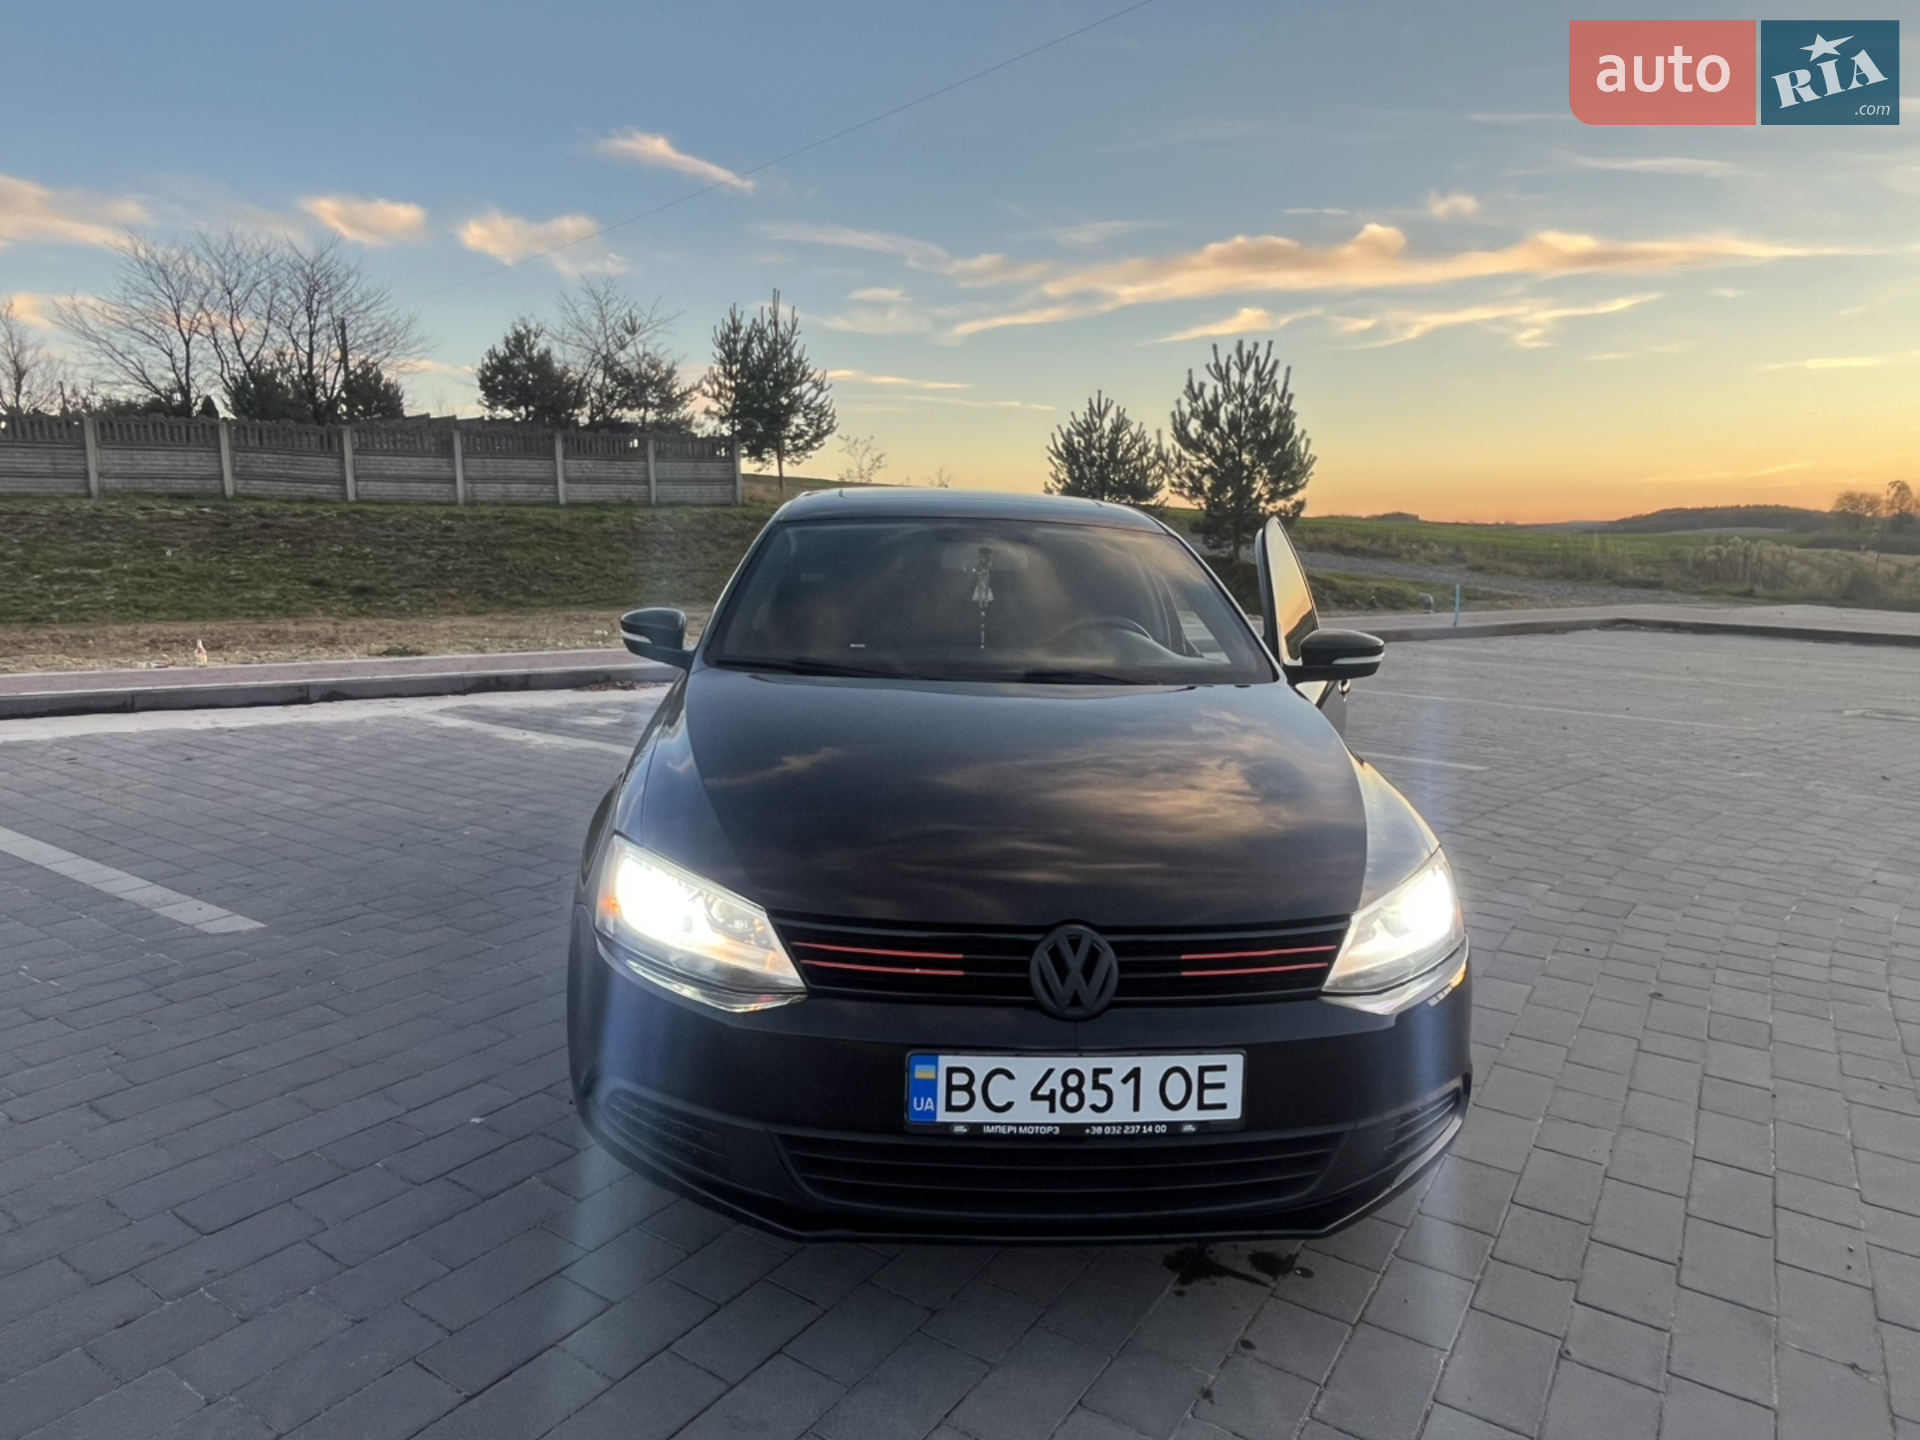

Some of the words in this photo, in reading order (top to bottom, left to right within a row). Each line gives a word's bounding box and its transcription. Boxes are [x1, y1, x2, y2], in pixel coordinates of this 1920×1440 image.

[945, 1065, 1016, 1114] BC
[1030, 1066, 1142, 1114] 4851
[1159, 1064, 1228, 1112] OE
[913, 1097, 935, 1112] UA
[1085, 1125, 1102, 1135] +38
[1104, 1125, 1122, 1135] 032
[1123, 1124, 1141, 1134] 237
[1142, 1124, 1153, 1134] 14
[1154, 1123, 1168, 1133] 00
